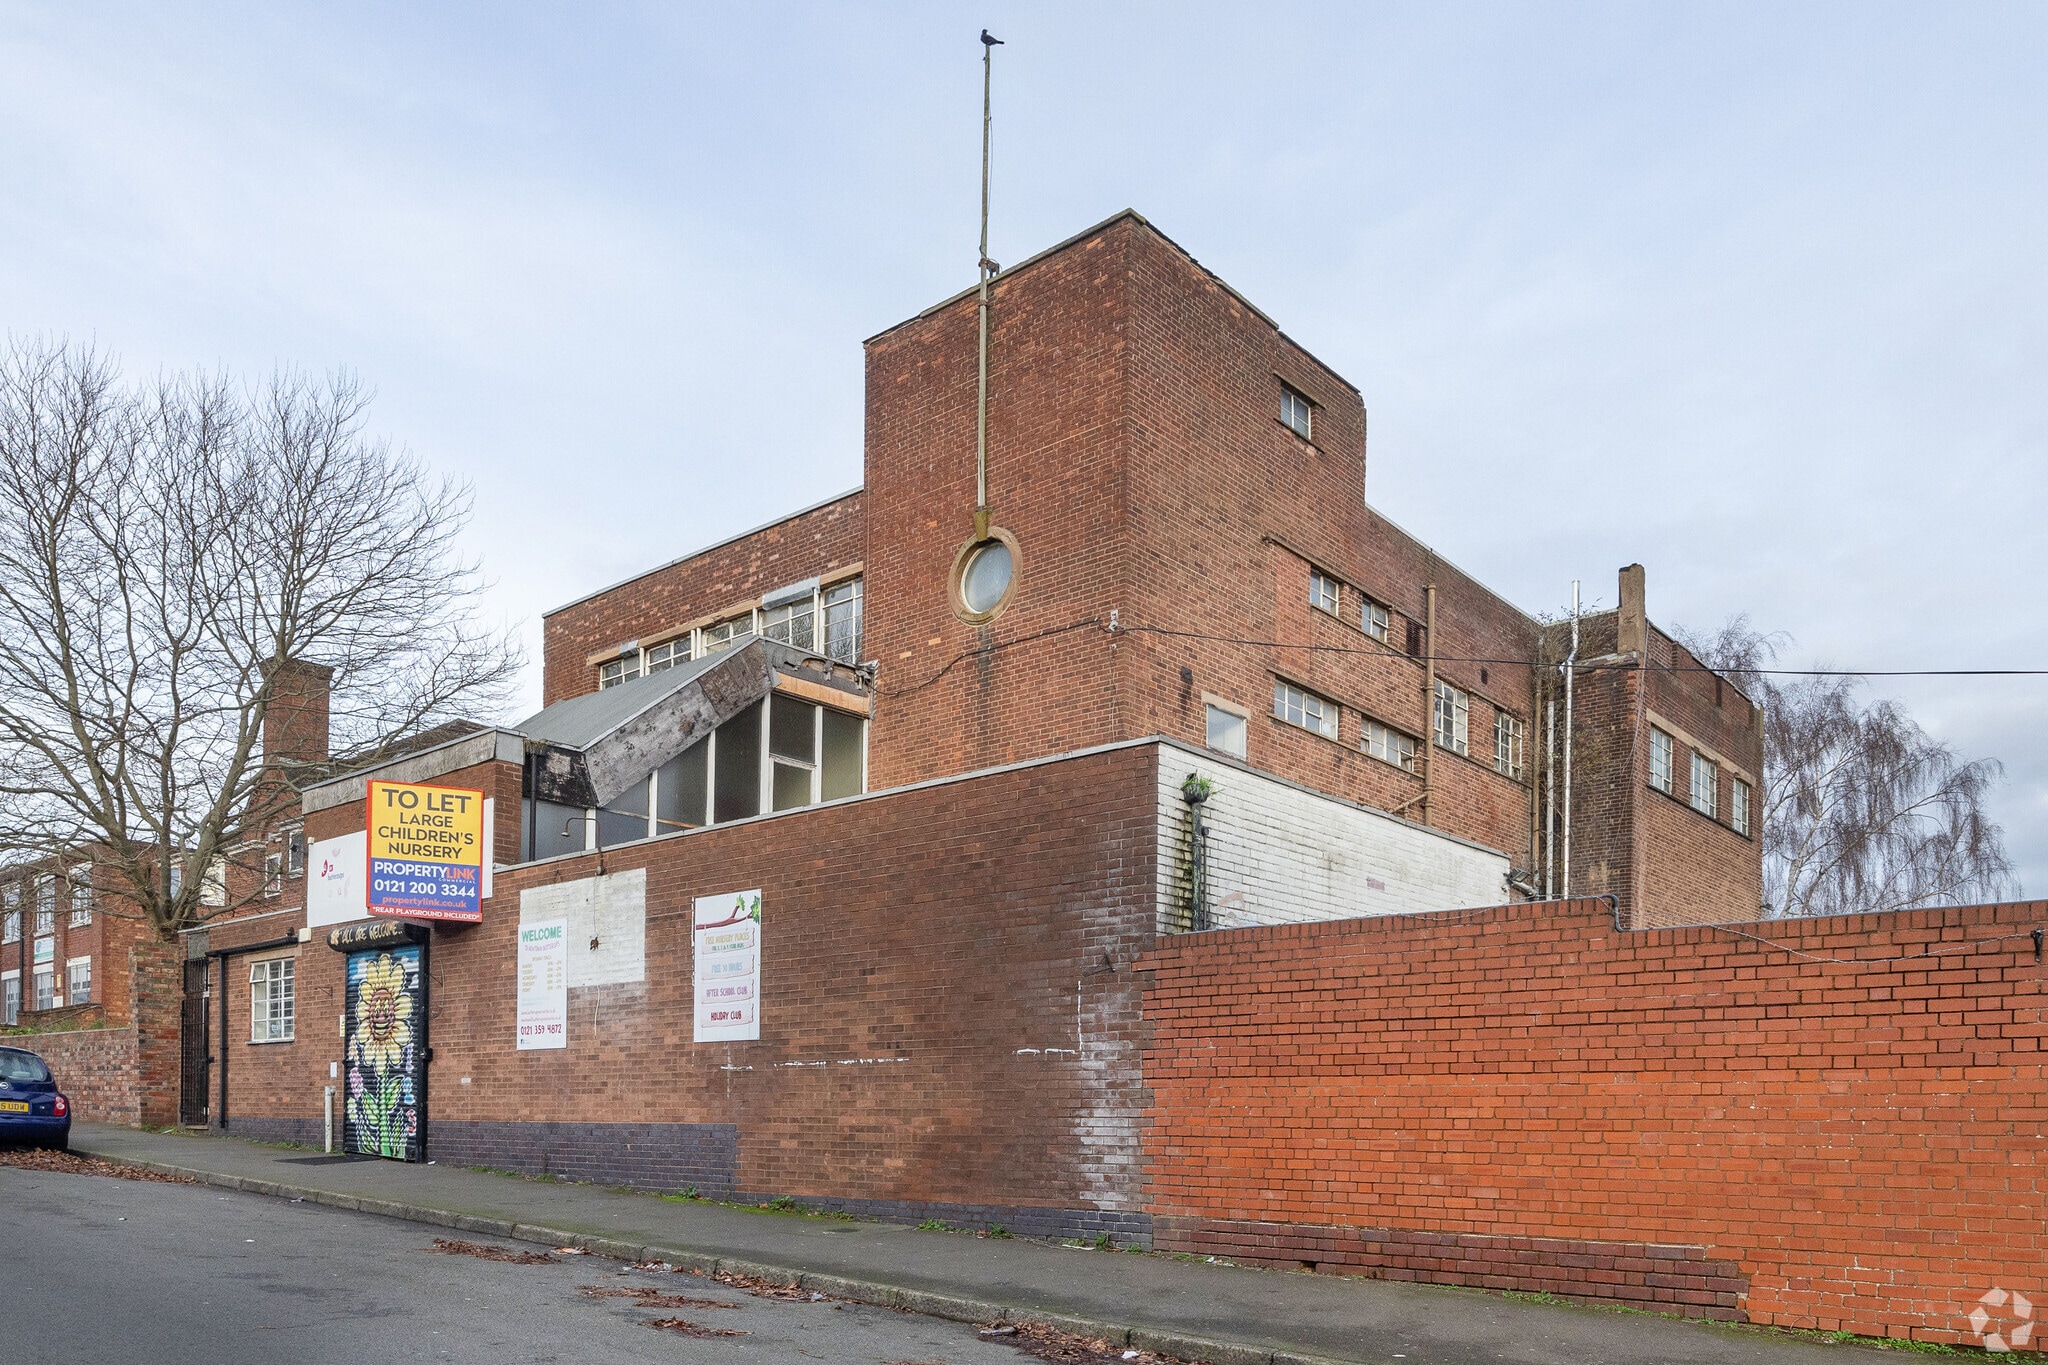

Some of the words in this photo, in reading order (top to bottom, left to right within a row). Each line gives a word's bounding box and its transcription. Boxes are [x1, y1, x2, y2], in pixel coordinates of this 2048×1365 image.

[382, 789, 419, 809] TO
[427, 793, 471, 813] LET
[400, 812, 453, 828] LARGE
[378, 826, 474, 845] CHILDREN'S
[388, 842, 462, 859] NURSERY
[374, 862, 476, 880] PROPERTYLINK
[374, 879, 405, 893] 0121
[409, 881, 436, 895] 200
[441, 884, 476, 897] 3344
[382, 896, 467, 908] propertylink.co.uk
[396, 908, 442, 918] PLAYGROUND
[355, 925, 367, 941] ARE
[522, 926, 562, 943] WELCOME
[706, 988, 719, 998] AFTER
[720, 986, 736, 997] SCHOOL
[737, 985, 748, 995] CLUB
[711, 1011, 729, 1021] HOLIDAY
[730, 1010, 742, 1020] CLUB
[521, 1026, 532, 1036] 0121
[534, 1025, 544, 1035] 359
[547, 1024, 562, 1034] 4872
